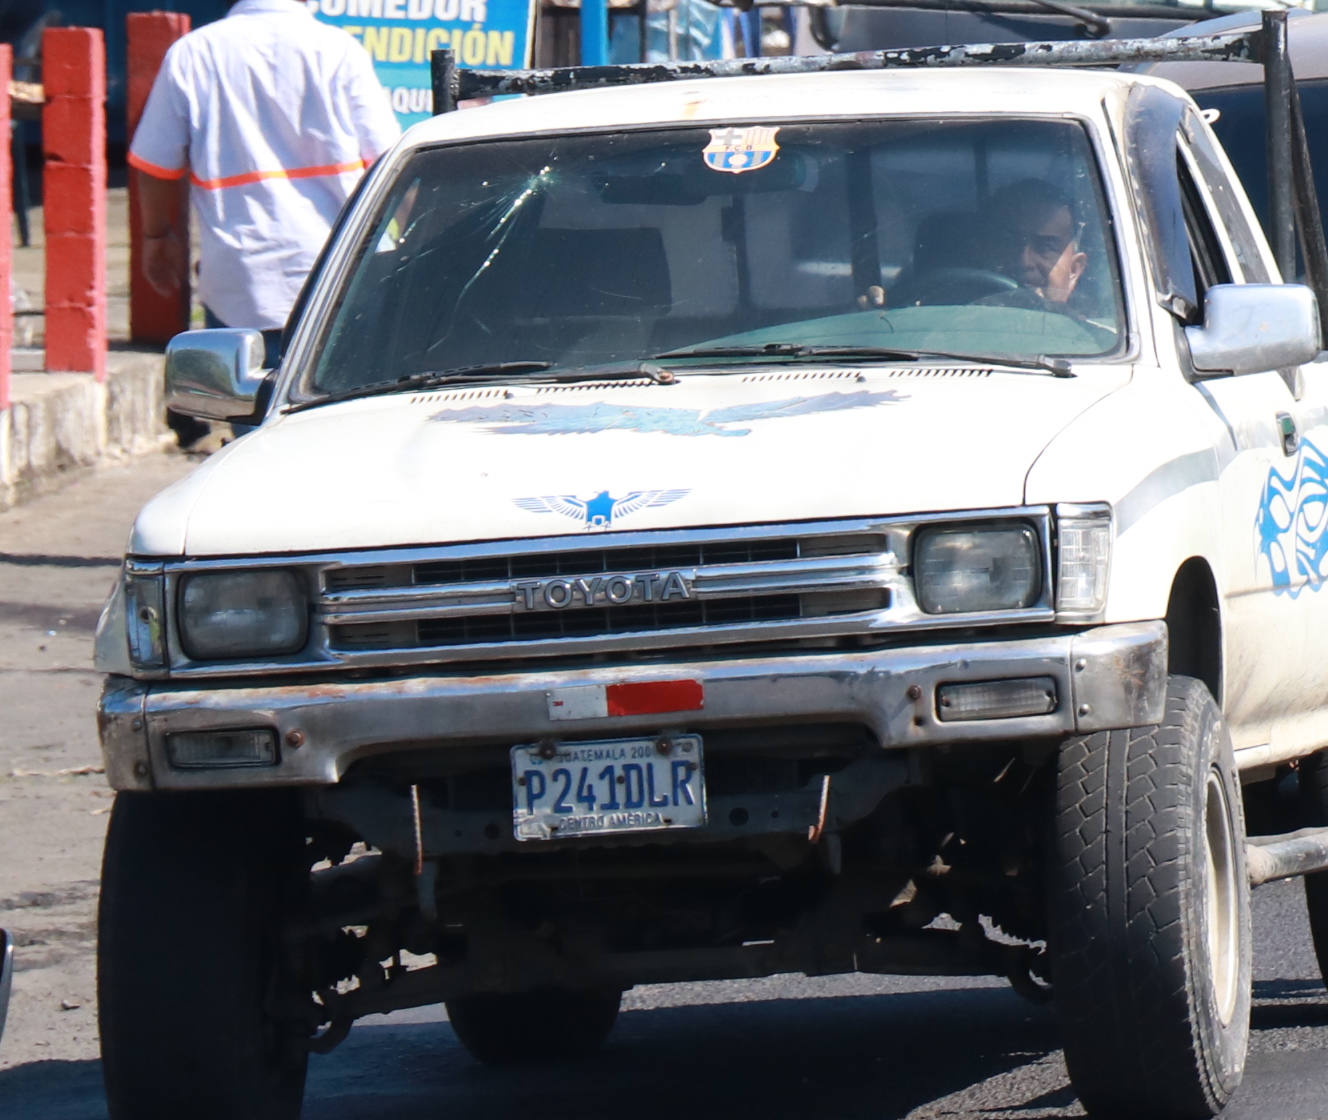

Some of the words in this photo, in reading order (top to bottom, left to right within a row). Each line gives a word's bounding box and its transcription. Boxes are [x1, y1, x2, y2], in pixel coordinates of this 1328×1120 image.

[516, 571, 691, 611] TOYOTA
[523, 759, 696, 816] P241DLR
[559, 814, 605, 831] CENTRO
